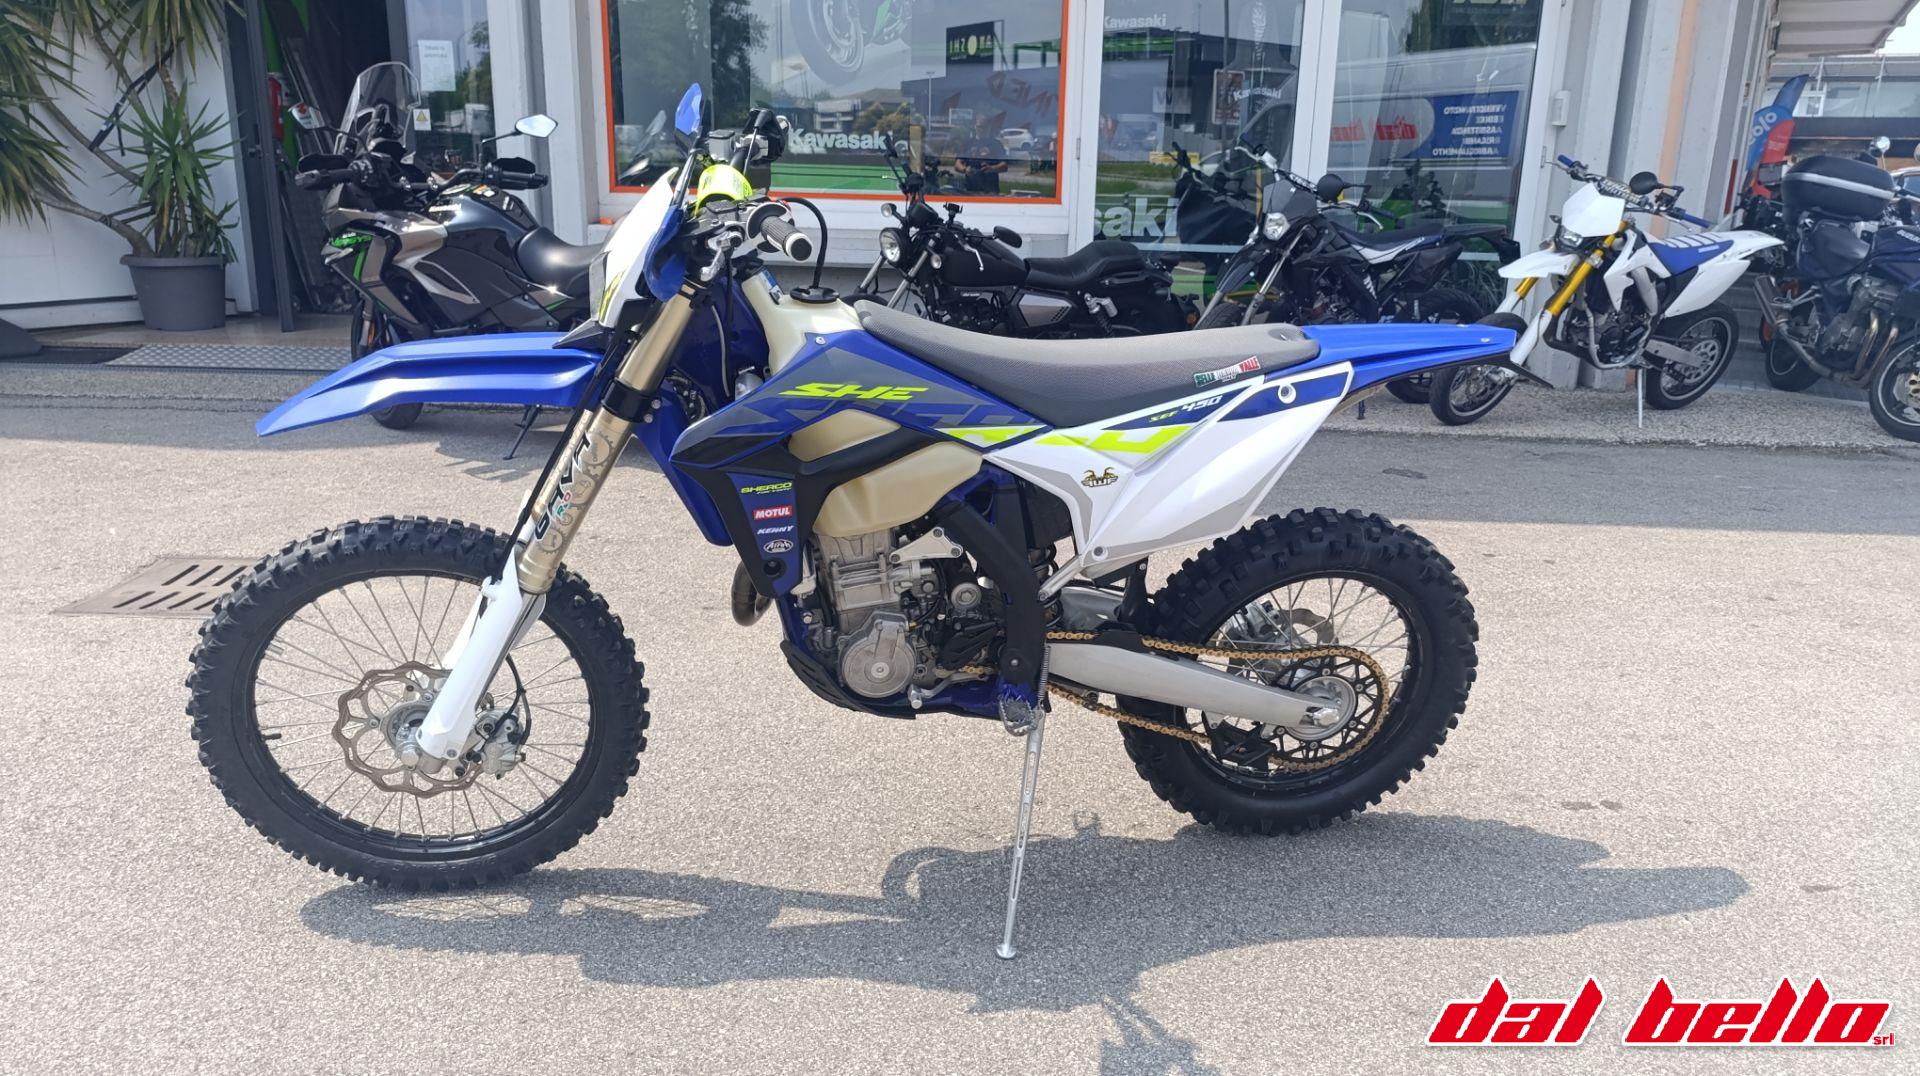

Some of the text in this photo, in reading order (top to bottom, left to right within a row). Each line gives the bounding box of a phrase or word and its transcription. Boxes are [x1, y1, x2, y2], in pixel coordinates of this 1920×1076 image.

[1232, 86, 1282, 101] Kawasaki
[1181, 394, 1224, 412] 450
[741, 482, 792, 494] SHERCO
[755, 507, 791, 519] MOTUL
[757, 525, 796, 535] KENNY
